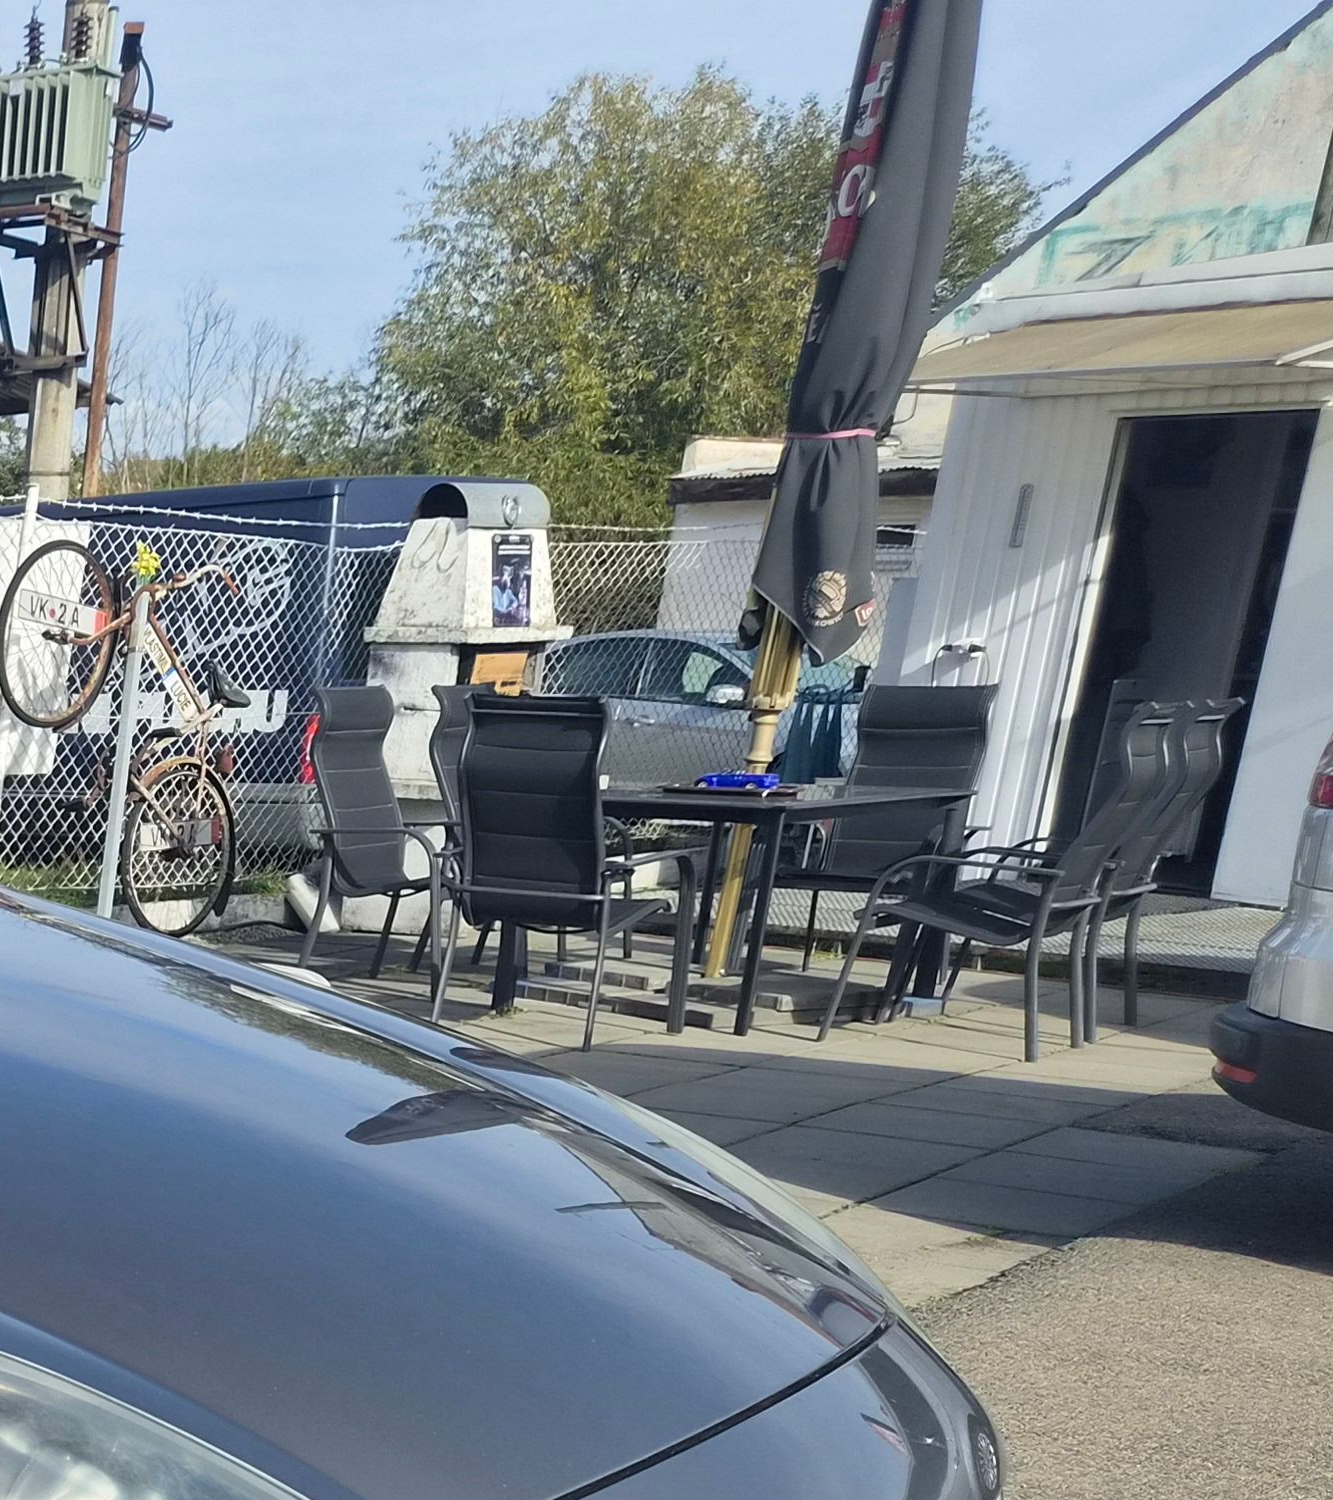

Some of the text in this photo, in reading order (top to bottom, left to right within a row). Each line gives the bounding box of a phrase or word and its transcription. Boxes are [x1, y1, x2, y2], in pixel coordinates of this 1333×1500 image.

[30, 594, 80, 627] VK 2 A
[170, 681, 192, 712] LUCIE
